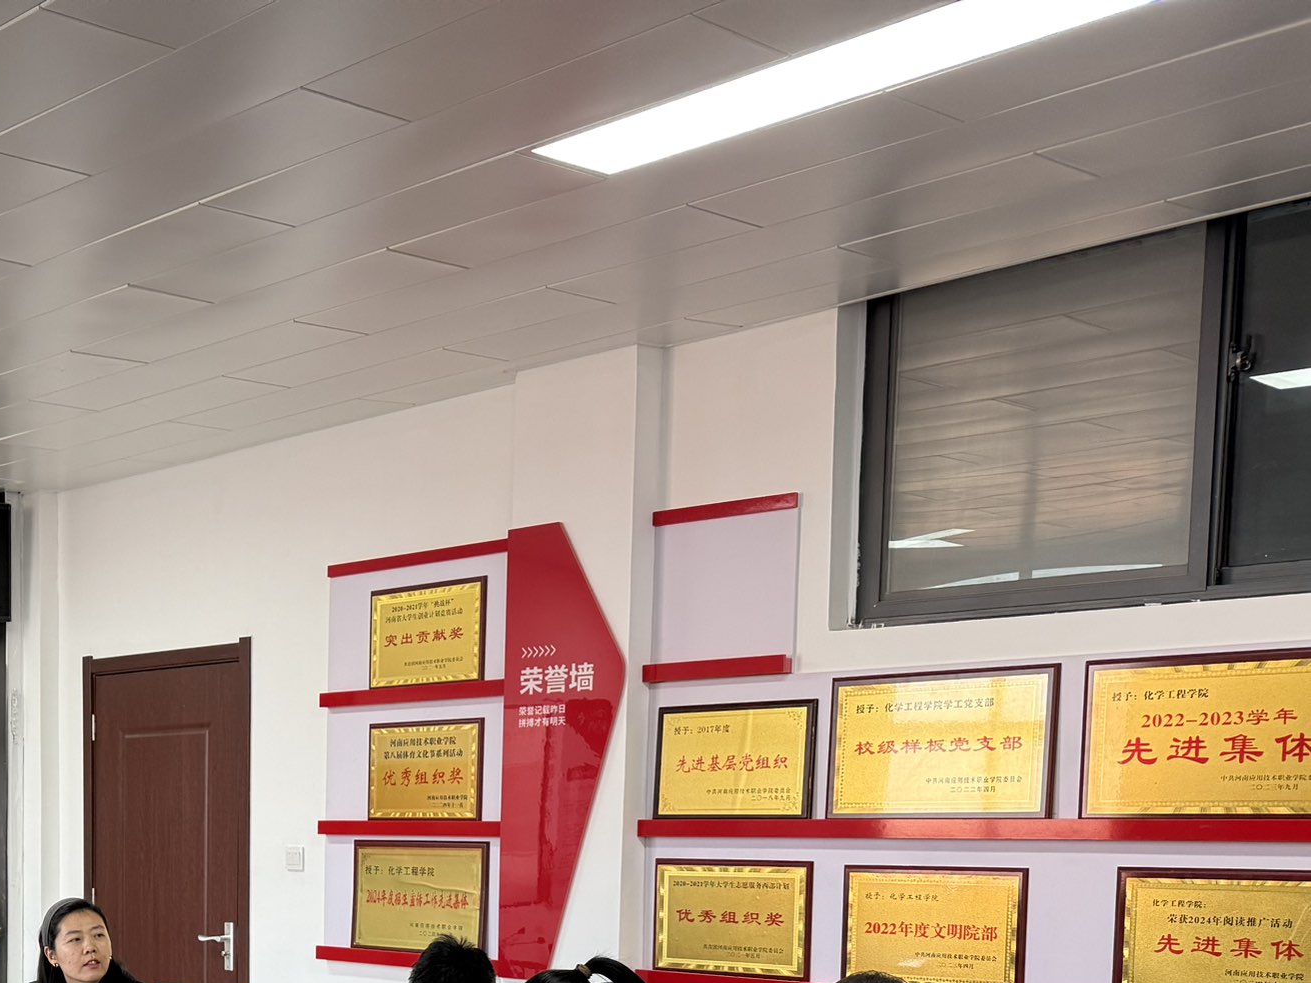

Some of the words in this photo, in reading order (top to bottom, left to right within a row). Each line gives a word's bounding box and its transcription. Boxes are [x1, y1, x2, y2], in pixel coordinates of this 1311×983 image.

[384, 626, 464, 648] 突出贡献奖
[519, 662, 595, 696] 荣誉墙
[518, 704, 566, 716] 荣誉记载昨日
[1141, 708, 1298, 728] 2022-2023学年
[518, 716, 566, 728] 拼搏才有明天
[390, 736, 457, 748] 河南应用技术职业学院
[854, 735, 1023, 755] 校级样板党支部
[1118, 732, 1311, 765] 先进集体
[675, 752, 789, 773] 先进基层党组织
[382, 766, 464, 788] 优秀组织奖
[676, 909, 785, 927] 优秀组织奖
[1167, 914, 1293, 928] 荣获2024年阅读推广活动
[864, 921, 998, 942] 2022年度文明院部
[1154, 934, 1304, 961] 先进集体
